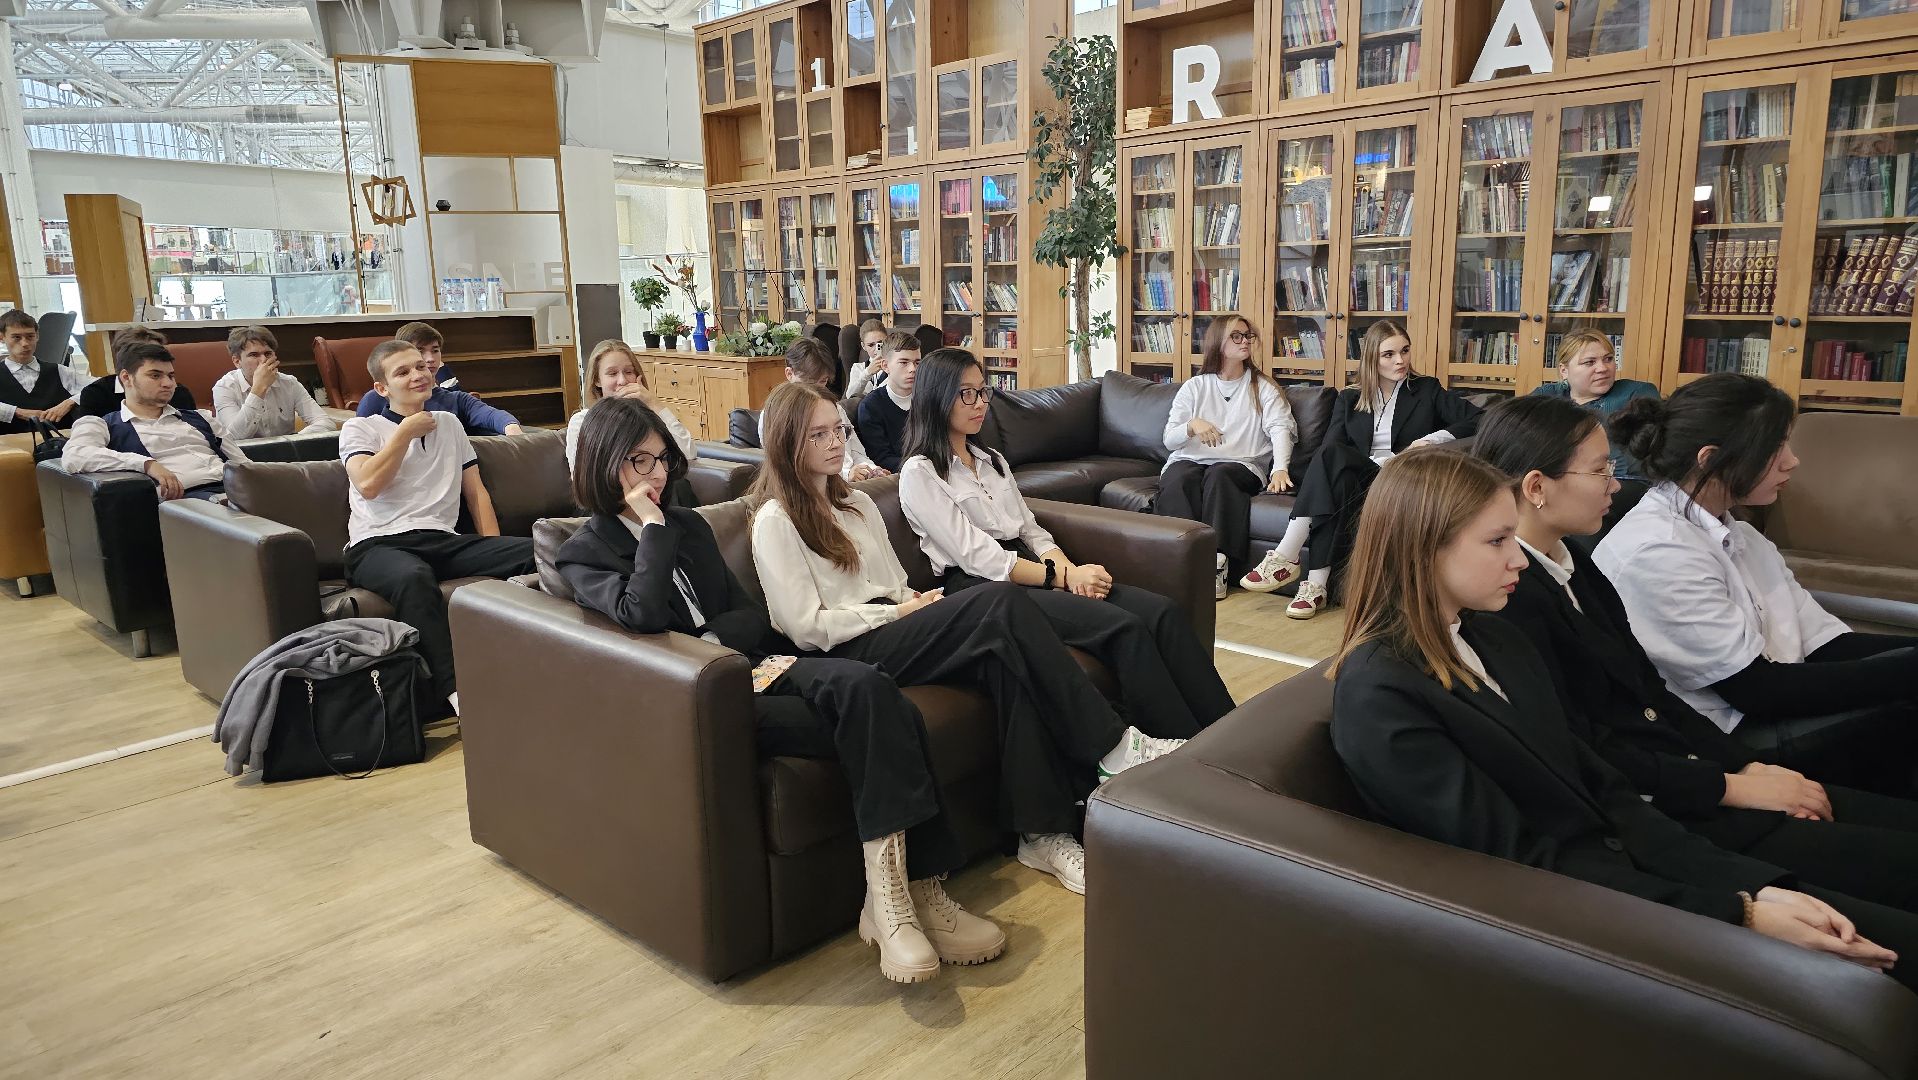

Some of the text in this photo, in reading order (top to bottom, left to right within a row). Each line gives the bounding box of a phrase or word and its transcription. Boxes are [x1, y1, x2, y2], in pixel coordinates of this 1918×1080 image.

[810, 57, 830, 92] 1
[1469, 0, 1553, 82] A
[1172, 44, 1223, 124] R
